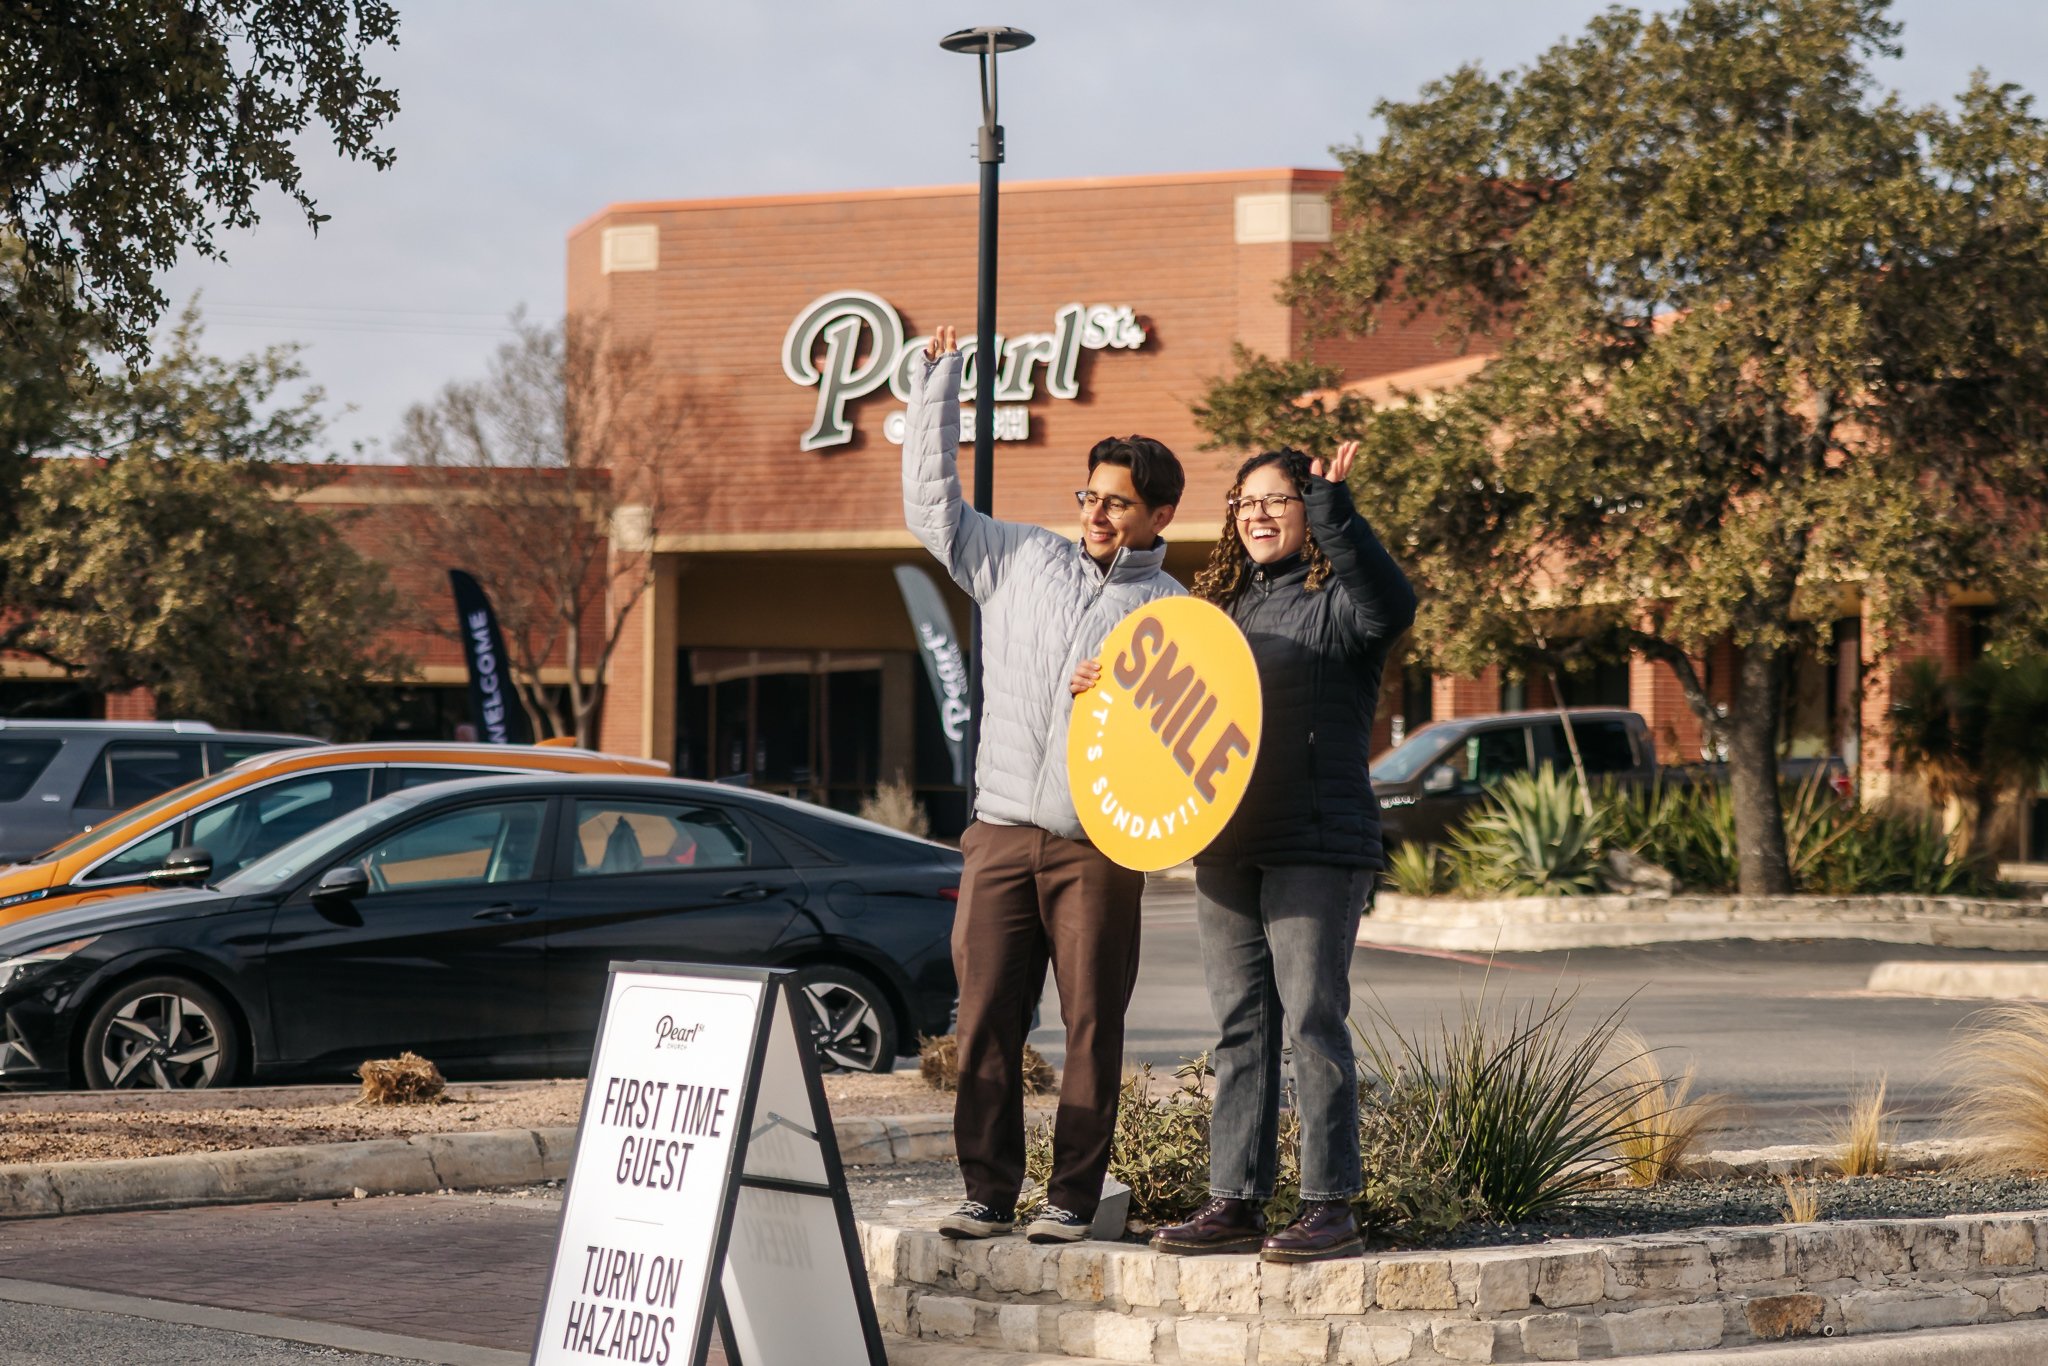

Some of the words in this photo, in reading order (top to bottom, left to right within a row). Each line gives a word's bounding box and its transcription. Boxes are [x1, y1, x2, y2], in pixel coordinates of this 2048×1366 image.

[883, 405, 1029, 445] CRH
[468, 609, 507, 744] WELCOME
[924, 633, 971, 741] Pearl
[1087, 691, 1113, 761] IT'S
[1113, 616, 1250, 805] SMILE
[1092, 776, 1199, 840] SUNDAY!!
[655, 1015, 699, 1049] Pearl
[601, 1077, 669, 1130] FIRST
[670, 1083, 729, 1138] TIME
[616, 1135, 694, 1192] GUEST
[581, 1245, 645, 1303] TURN
[645, 1255, 683, 1310] ON
[562, 1301, 675, 1366] HAZARDS
